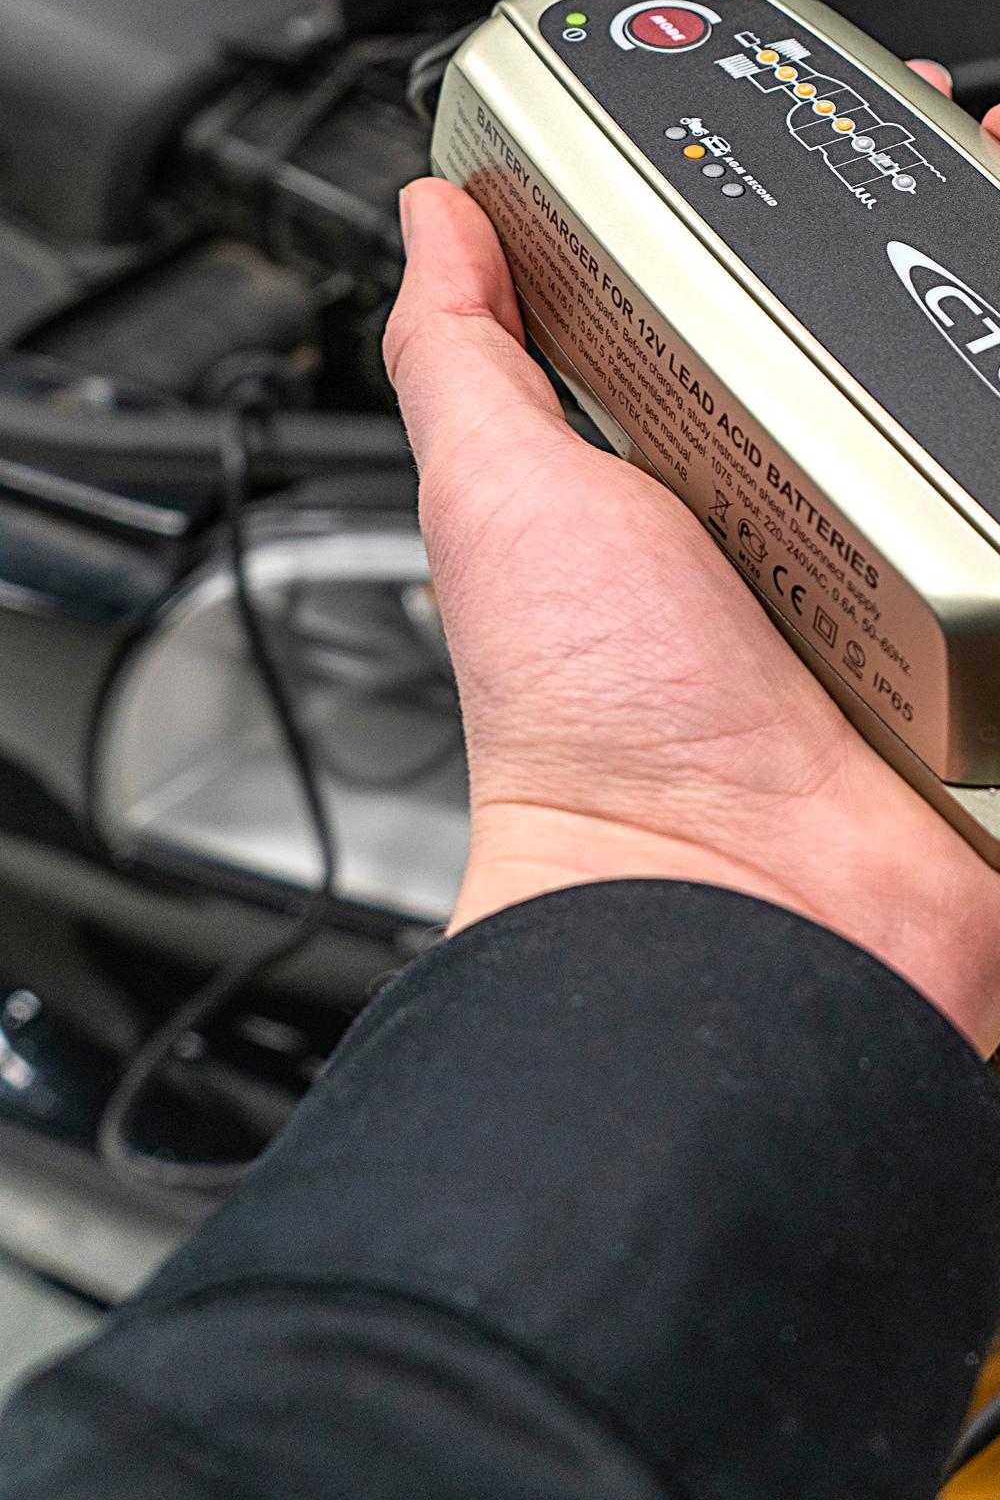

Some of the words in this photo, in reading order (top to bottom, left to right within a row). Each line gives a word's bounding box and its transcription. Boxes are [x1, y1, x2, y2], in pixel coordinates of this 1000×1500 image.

[650, 15, 687, 41] MODE
[722, 157, 746, 175] AGM
[743, 175, 778, 207] RECOND
[477, 106, 530, 188] BATTERY
[532, 185, 599, 281] CHARGER
[602, 273, 633, 324] FOR
[638, 318, 666, 357] 12V
[669, 353, 714, 415] LEAD
[717, 413, 762, 468] ACID
[767, 464, 878, 589] BATTERIES
[524, 222, 535, 244] DC
[536, 241, 574, 297] connections.
[577, 293, 604, 335] Provide
[605, 328, 616, 348] for
[616, 346, 636, 374] good
[637, 371, 676, 423] ventilation.
[680, 419, 706, 457] Model:
[711, 456, 733, 490] 1075.
[736, 485, 760, 518] Input:
[531, 214, 556, 250] prevent
[557, 244, 579, 281] flames
[580, 277, 594, 299] and
[595, 296, 619, 331] sparks.
[622, 327, 648, 365] Before
[649, 362, 684, 412] charging,
[687, 407, 711, 440] study
[712, 436, 757, 491] instruction
[759, 488, 786, 521] sheet.
[790, 518, 845, 583] Disconnect
[847, 580, 881, 621] supply
[570, 331, 577, 345] in
[578, 339, 606, 383] Sweden
[607, 377, 617, 397] by
[618, 391, 641, 425] CTEK
[642, 420, 674, 465] Sweden
[674, 461, 688, 482] AB.
[608, 355, 642, 407] Patented,
[645, 403, 660, 425] see
[660, 422, 691, 463] manual.
[873, 672, 913, 722] IP65
